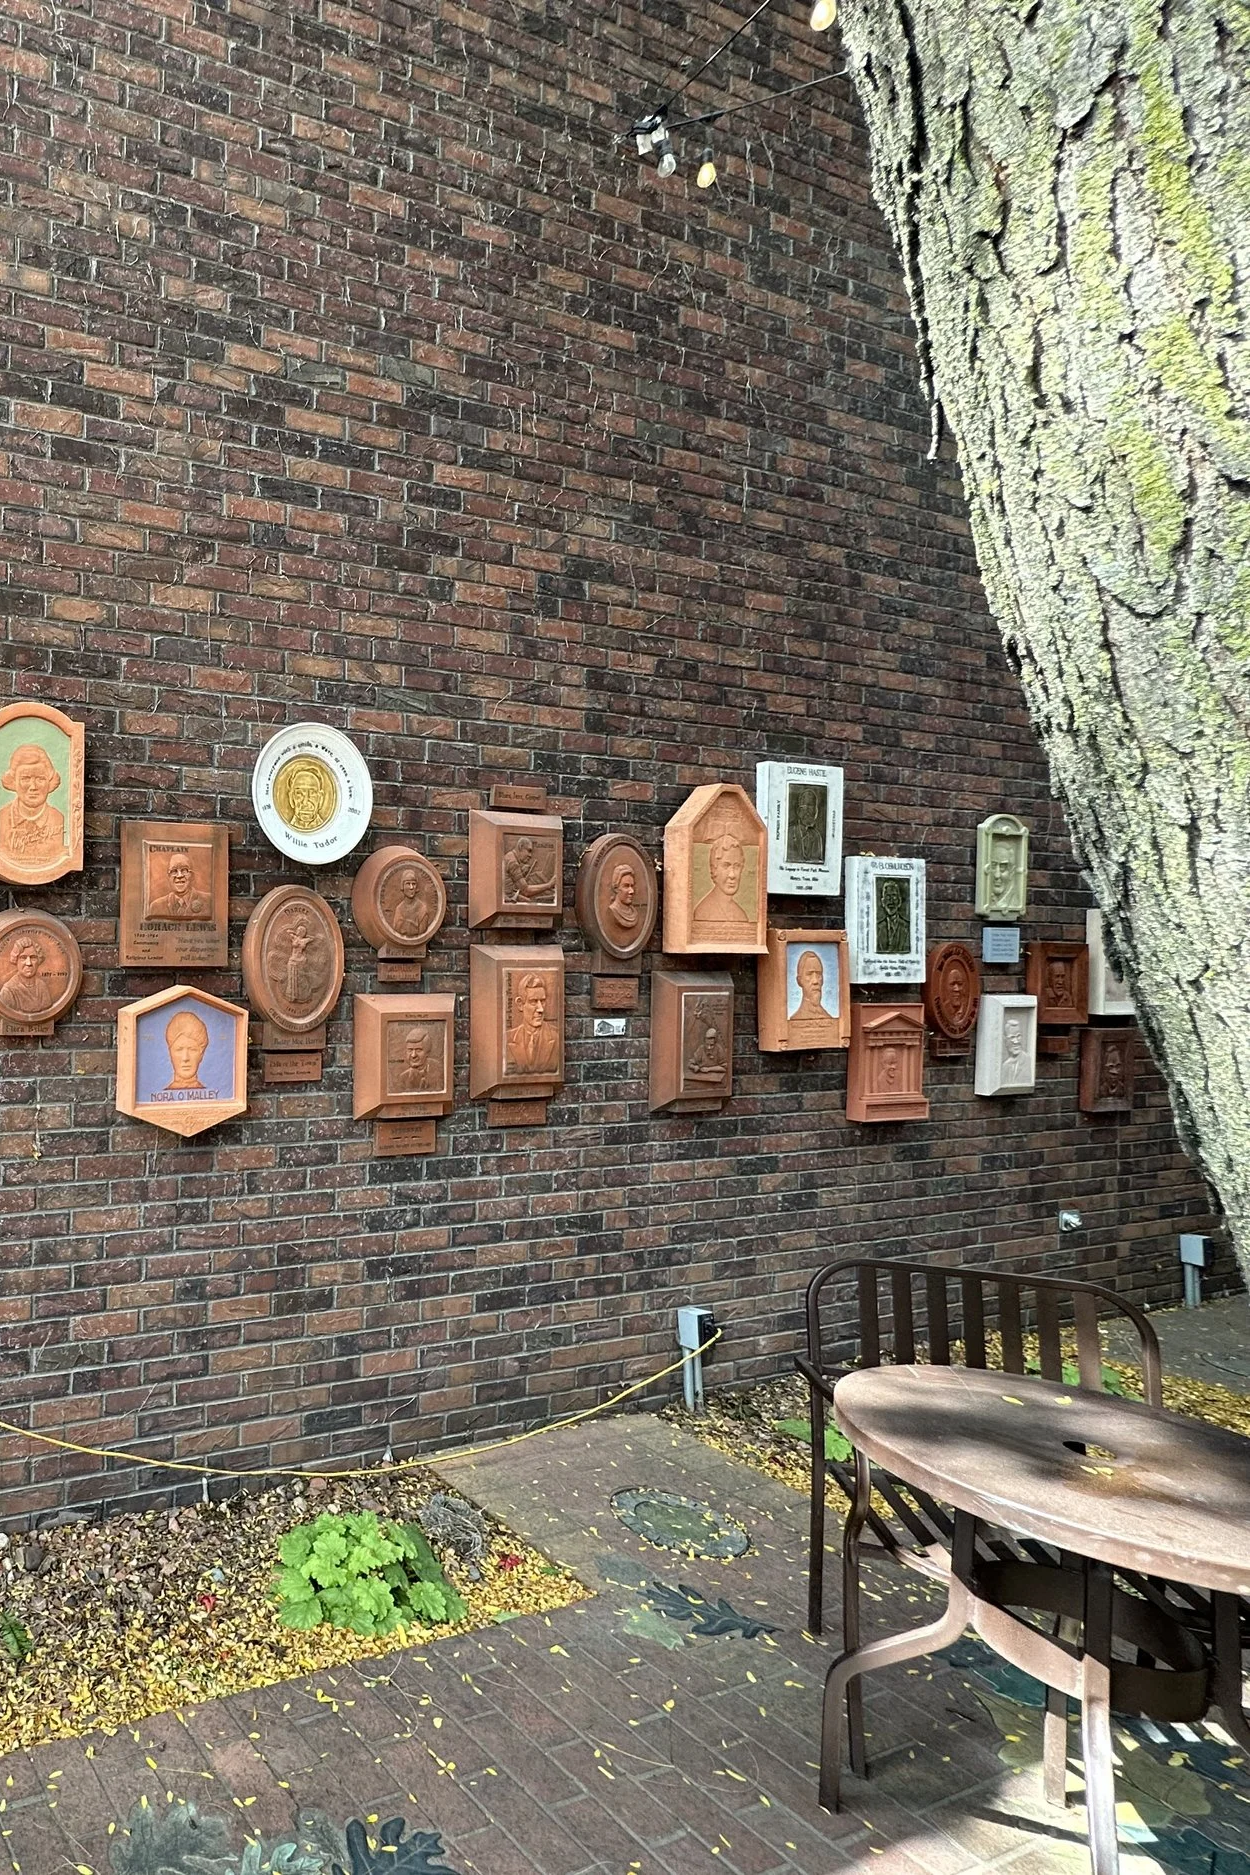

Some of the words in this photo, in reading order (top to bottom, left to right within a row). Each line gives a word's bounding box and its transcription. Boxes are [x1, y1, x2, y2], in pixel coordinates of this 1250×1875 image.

[284, 831, 308, 848] Willie
[312, 835, 338, 849] Tudor
[151, 1092, 174, 1102] NORA
